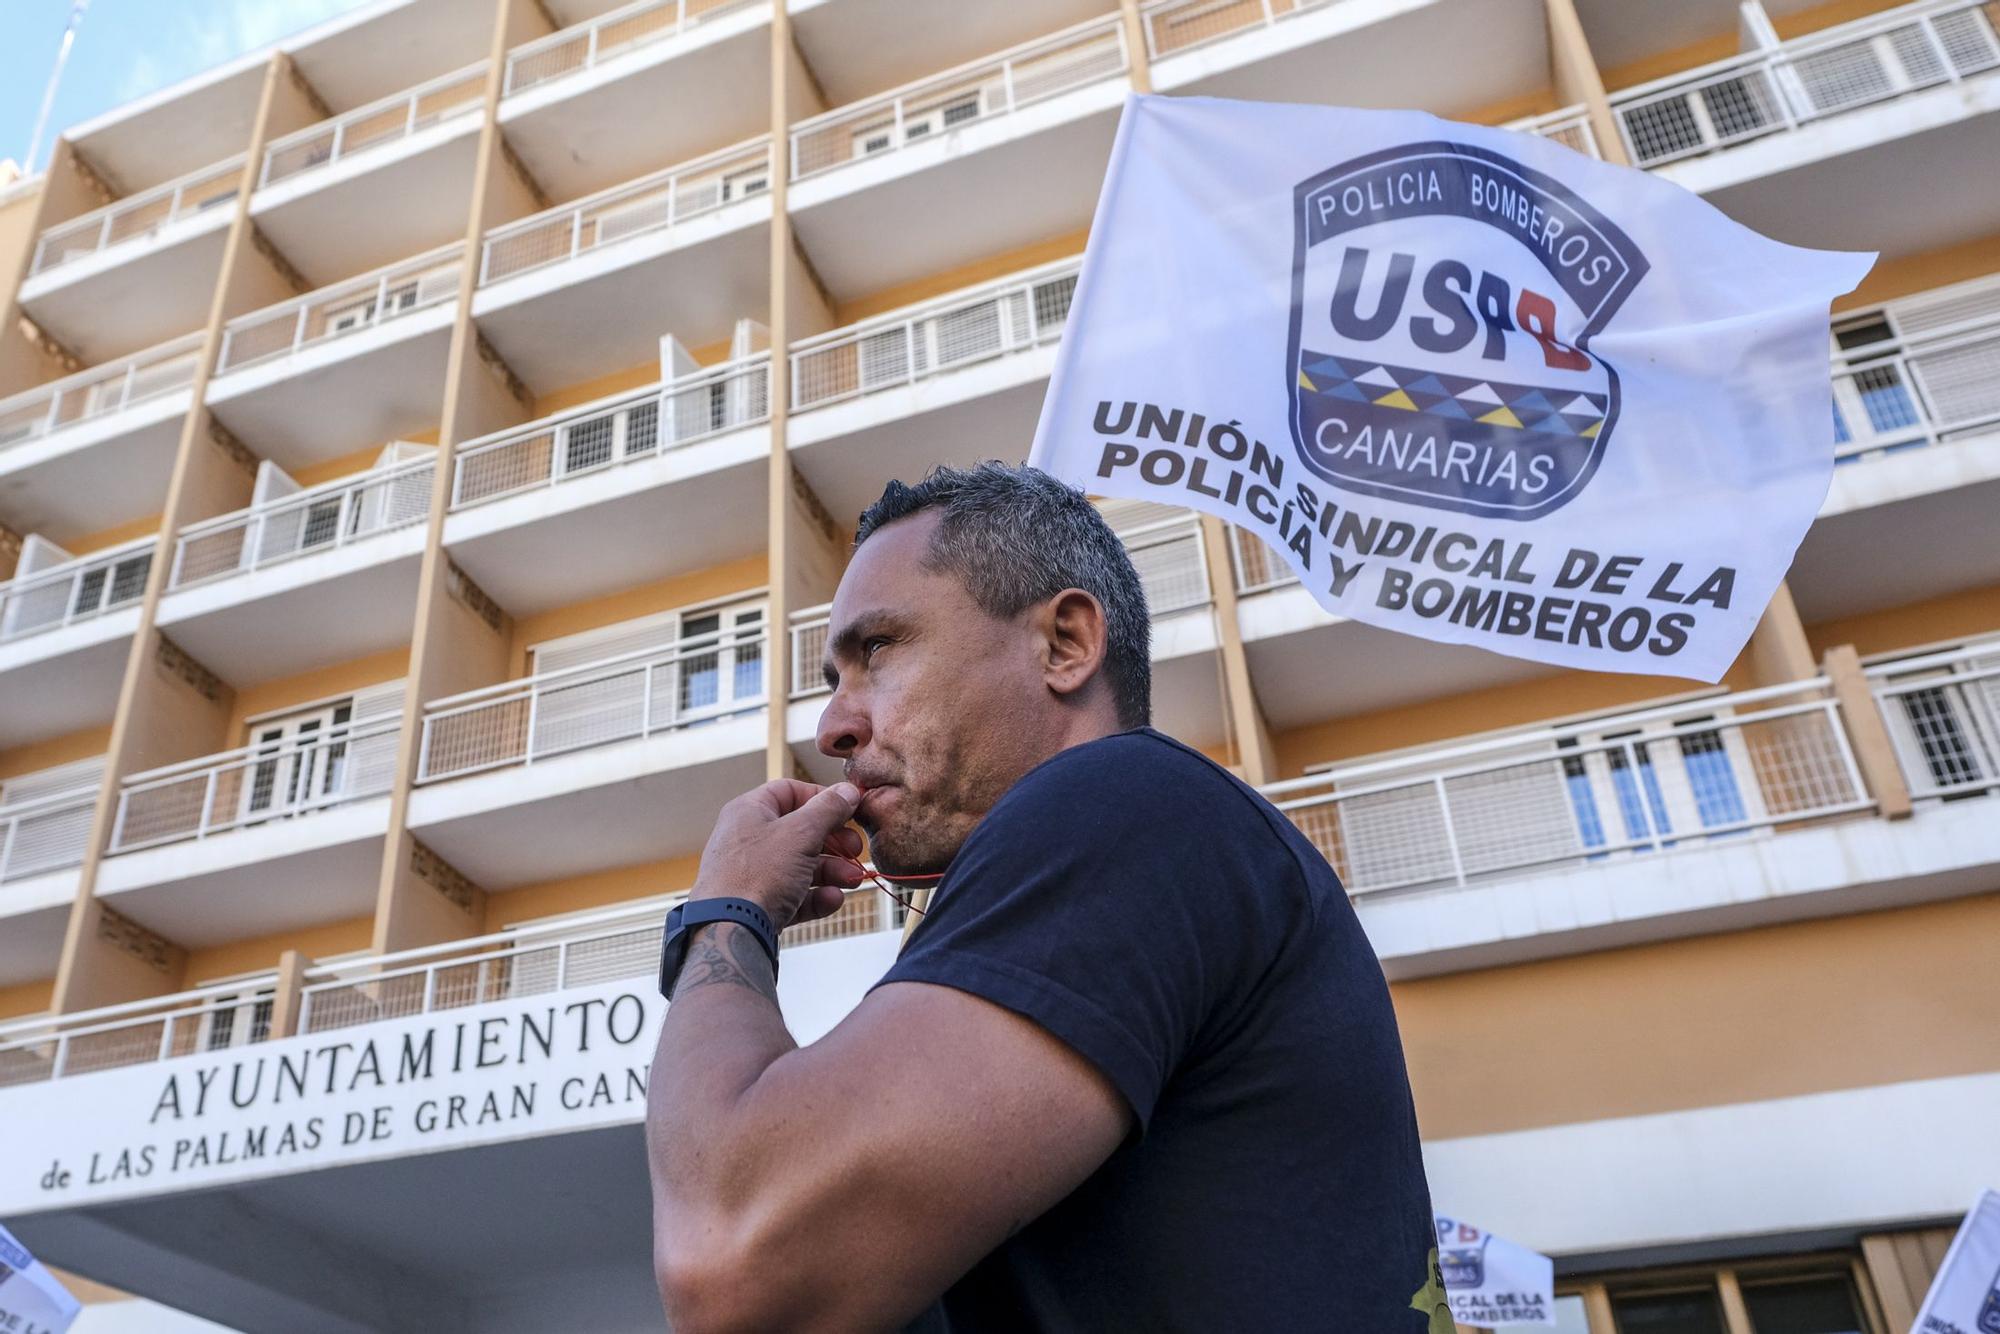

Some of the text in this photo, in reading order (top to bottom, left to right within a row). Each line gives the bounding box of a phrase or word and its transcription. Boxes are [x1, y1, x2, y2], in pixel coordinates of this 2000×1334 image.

[1317, 169, 1611, 286] POLICIA BOMBEROS
[1330, 246, 1592, 371] USPB
[1093, 400, 1736, 609] UNIÓN SINDICAL DE LA
[1315, 417, 1554, 494] CANARIAS
[1096, 442, 1695, 656] POLICÍA Y BOMBEROS
[150, 994, 645, 1124] AYUNTAMIENTO
[40, 1065, 649, 1190] de LAS PALMAS DE GRAN CAN
[1457, 1308, 1546, 1322] OMBEROS
